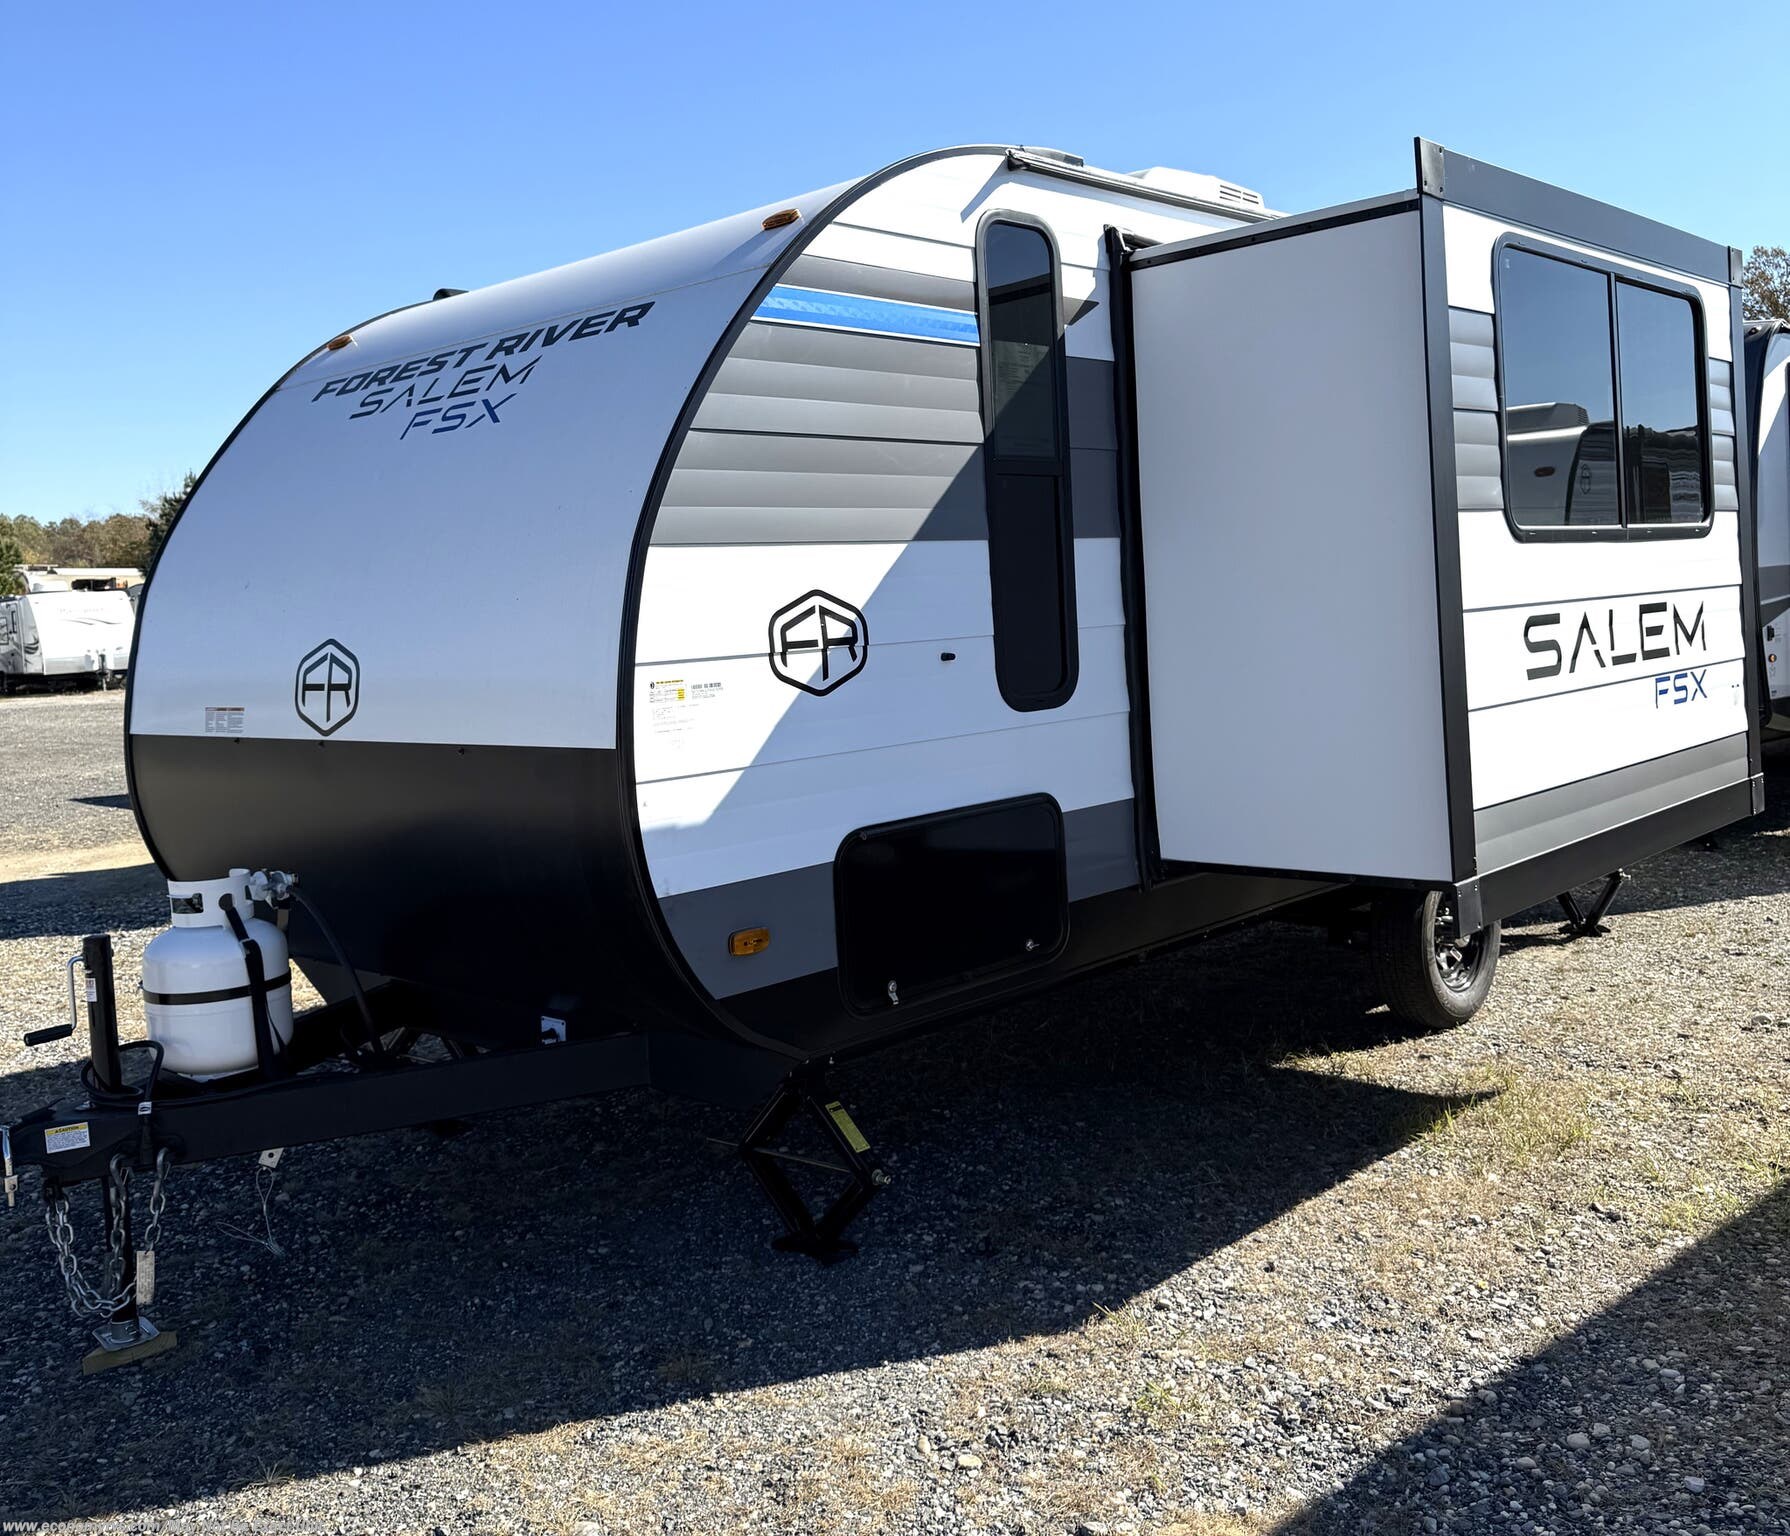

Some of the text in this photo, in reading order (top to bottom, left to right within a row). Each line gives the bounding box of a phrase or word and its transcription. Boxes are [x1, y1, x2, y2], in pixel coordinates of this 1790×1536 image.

[312, 301, 655, 403] FOREST RIVER
[349, 355, 543, 420] SALEM
[400, 393, 516, 440] FSX
[1523, 600, 1707, 681] SALEM
[1655, 669, 1708, 709] FSX
